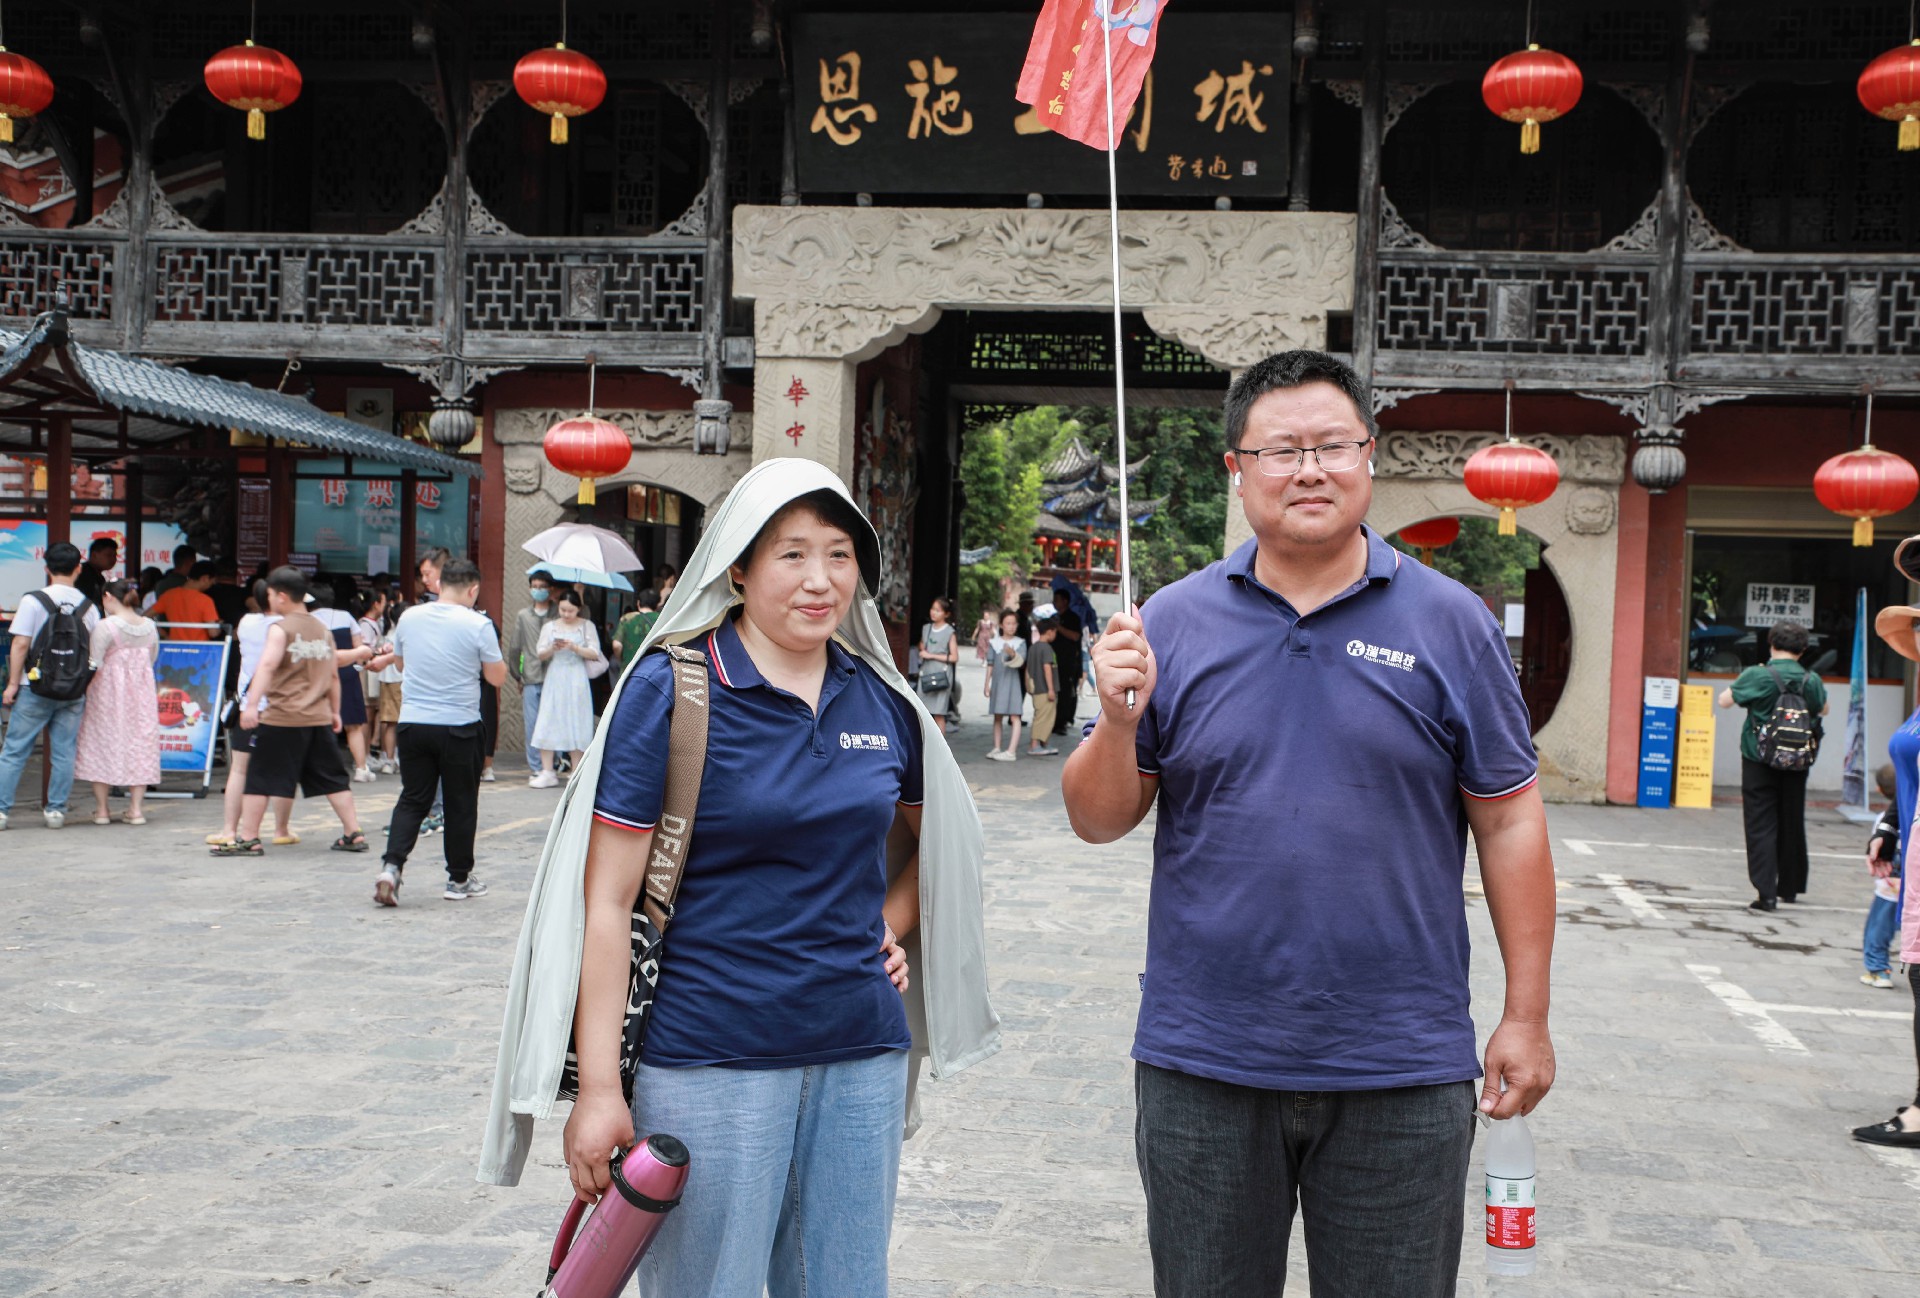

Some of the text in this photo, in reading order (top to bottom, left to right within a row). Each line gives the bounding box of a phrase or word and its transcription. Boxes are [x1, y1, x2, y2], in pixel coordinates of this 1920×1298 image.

[810, 50, 1274, 152] 恩施城
[1751, 585, 1811, 604] 讲解器
[1759, 604, 1802, 616] 办理处
[1365, 644, 1416, 668] 瑞气科技
